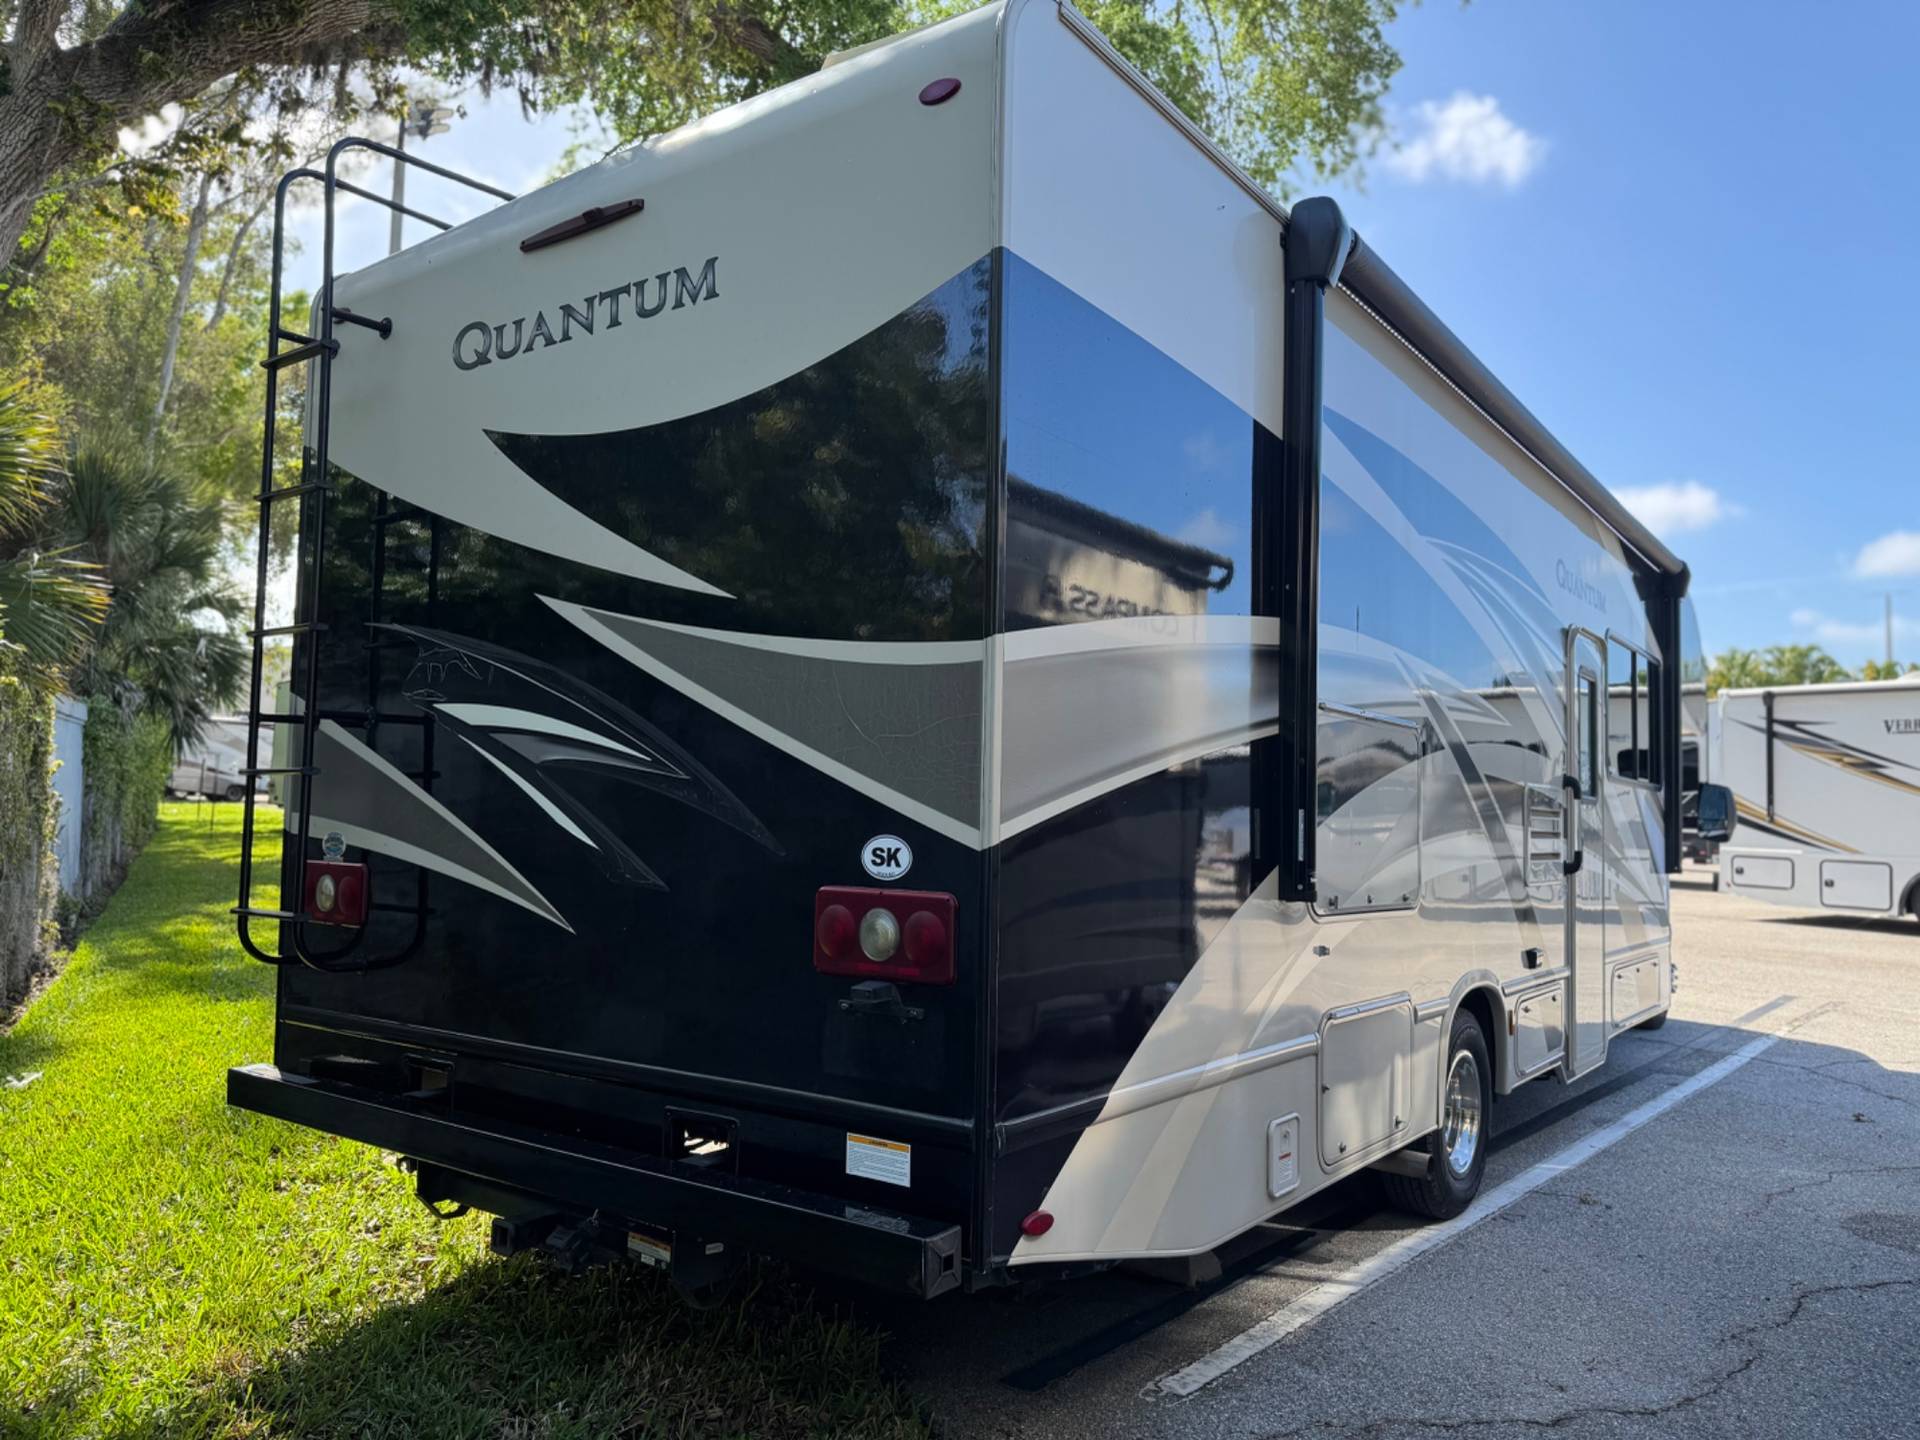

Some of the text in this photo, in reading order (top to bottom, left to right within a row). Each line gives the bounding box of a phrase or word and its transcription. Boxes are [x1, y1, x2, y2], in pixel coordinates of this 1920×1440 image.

[452, 256, 720, 370] QUANTUM
[1556, 557, 1607, 616] QUANTUM
[871, 847, 902, 868] SK
